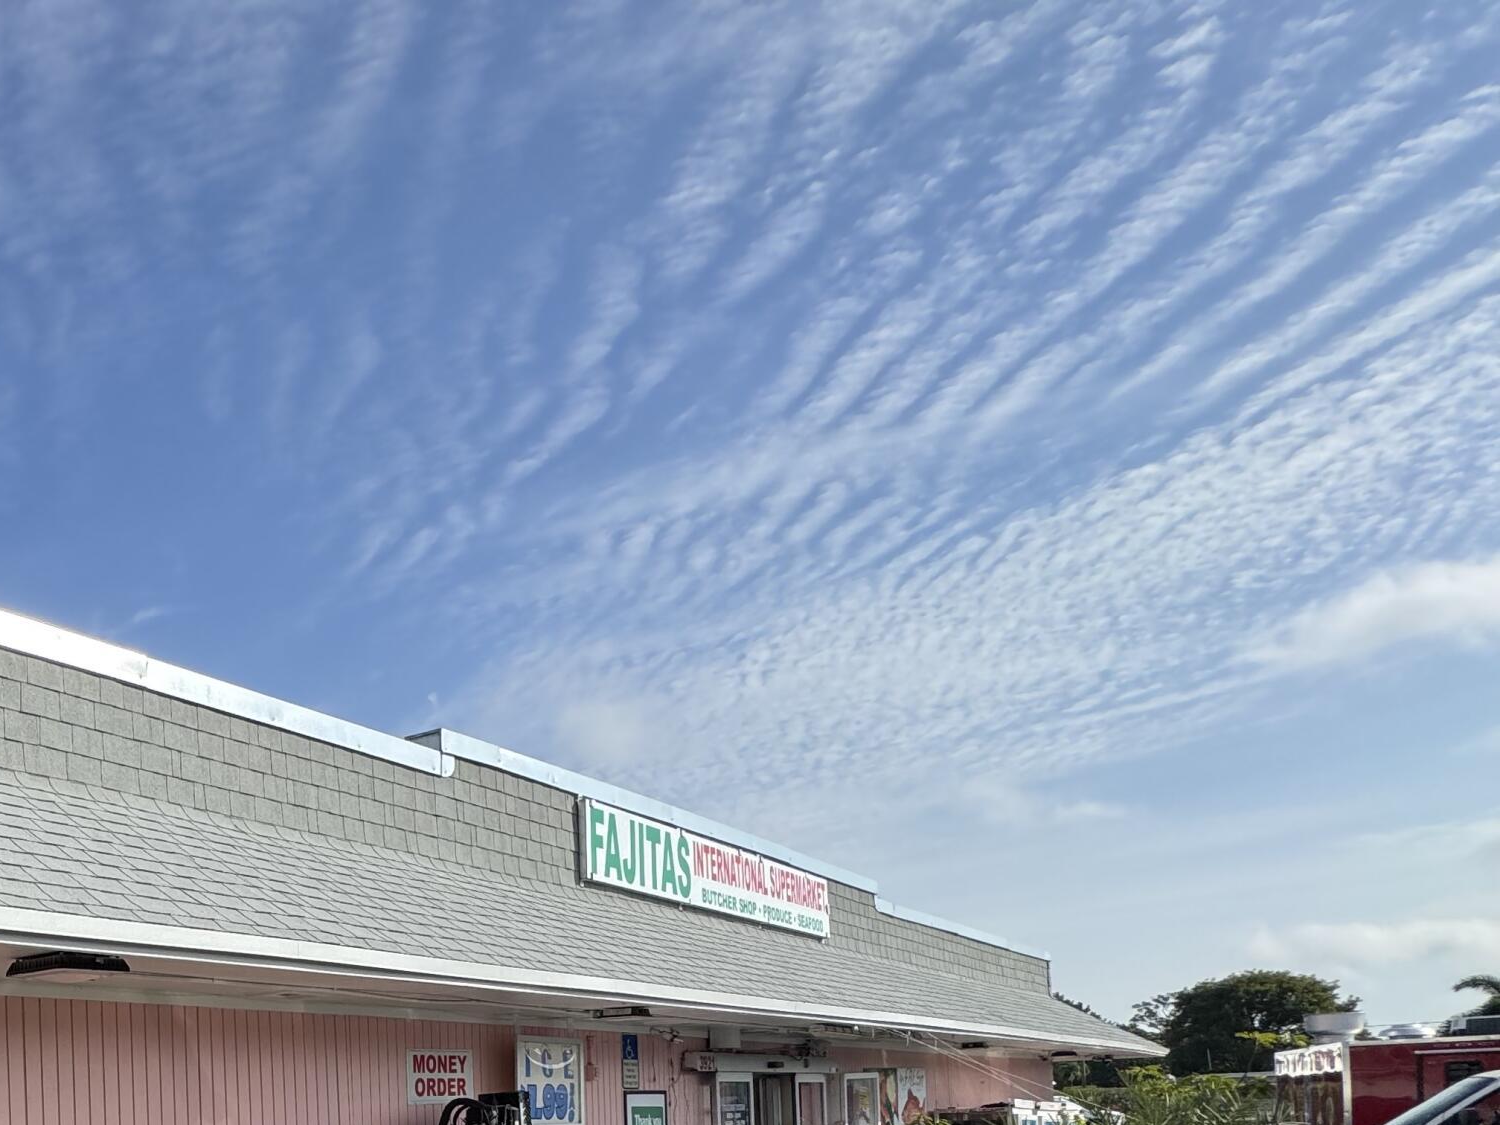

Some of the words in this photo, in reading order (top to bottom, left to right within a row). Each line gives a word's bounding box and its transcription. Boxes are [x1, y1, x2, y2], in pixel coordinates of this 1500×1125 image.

[590, 808, 692, 898] FAJITAS
[693, 841, 768, 895] INTERNATIONAL
[770, 866, 825, 912] SUPERMARKET
[702, 888, 738, 912] BUTCHER
[739, 898, 757, 915] SHOP
[763, 904, 793, 925] PRODUCE
[797, 913, 824, 932] SEAFOOD
[412, 1054, 467, 1074] MONEY
[525, 1045, 574, 1079] ICE
[414, 1077, 467, 1097] ORDER
